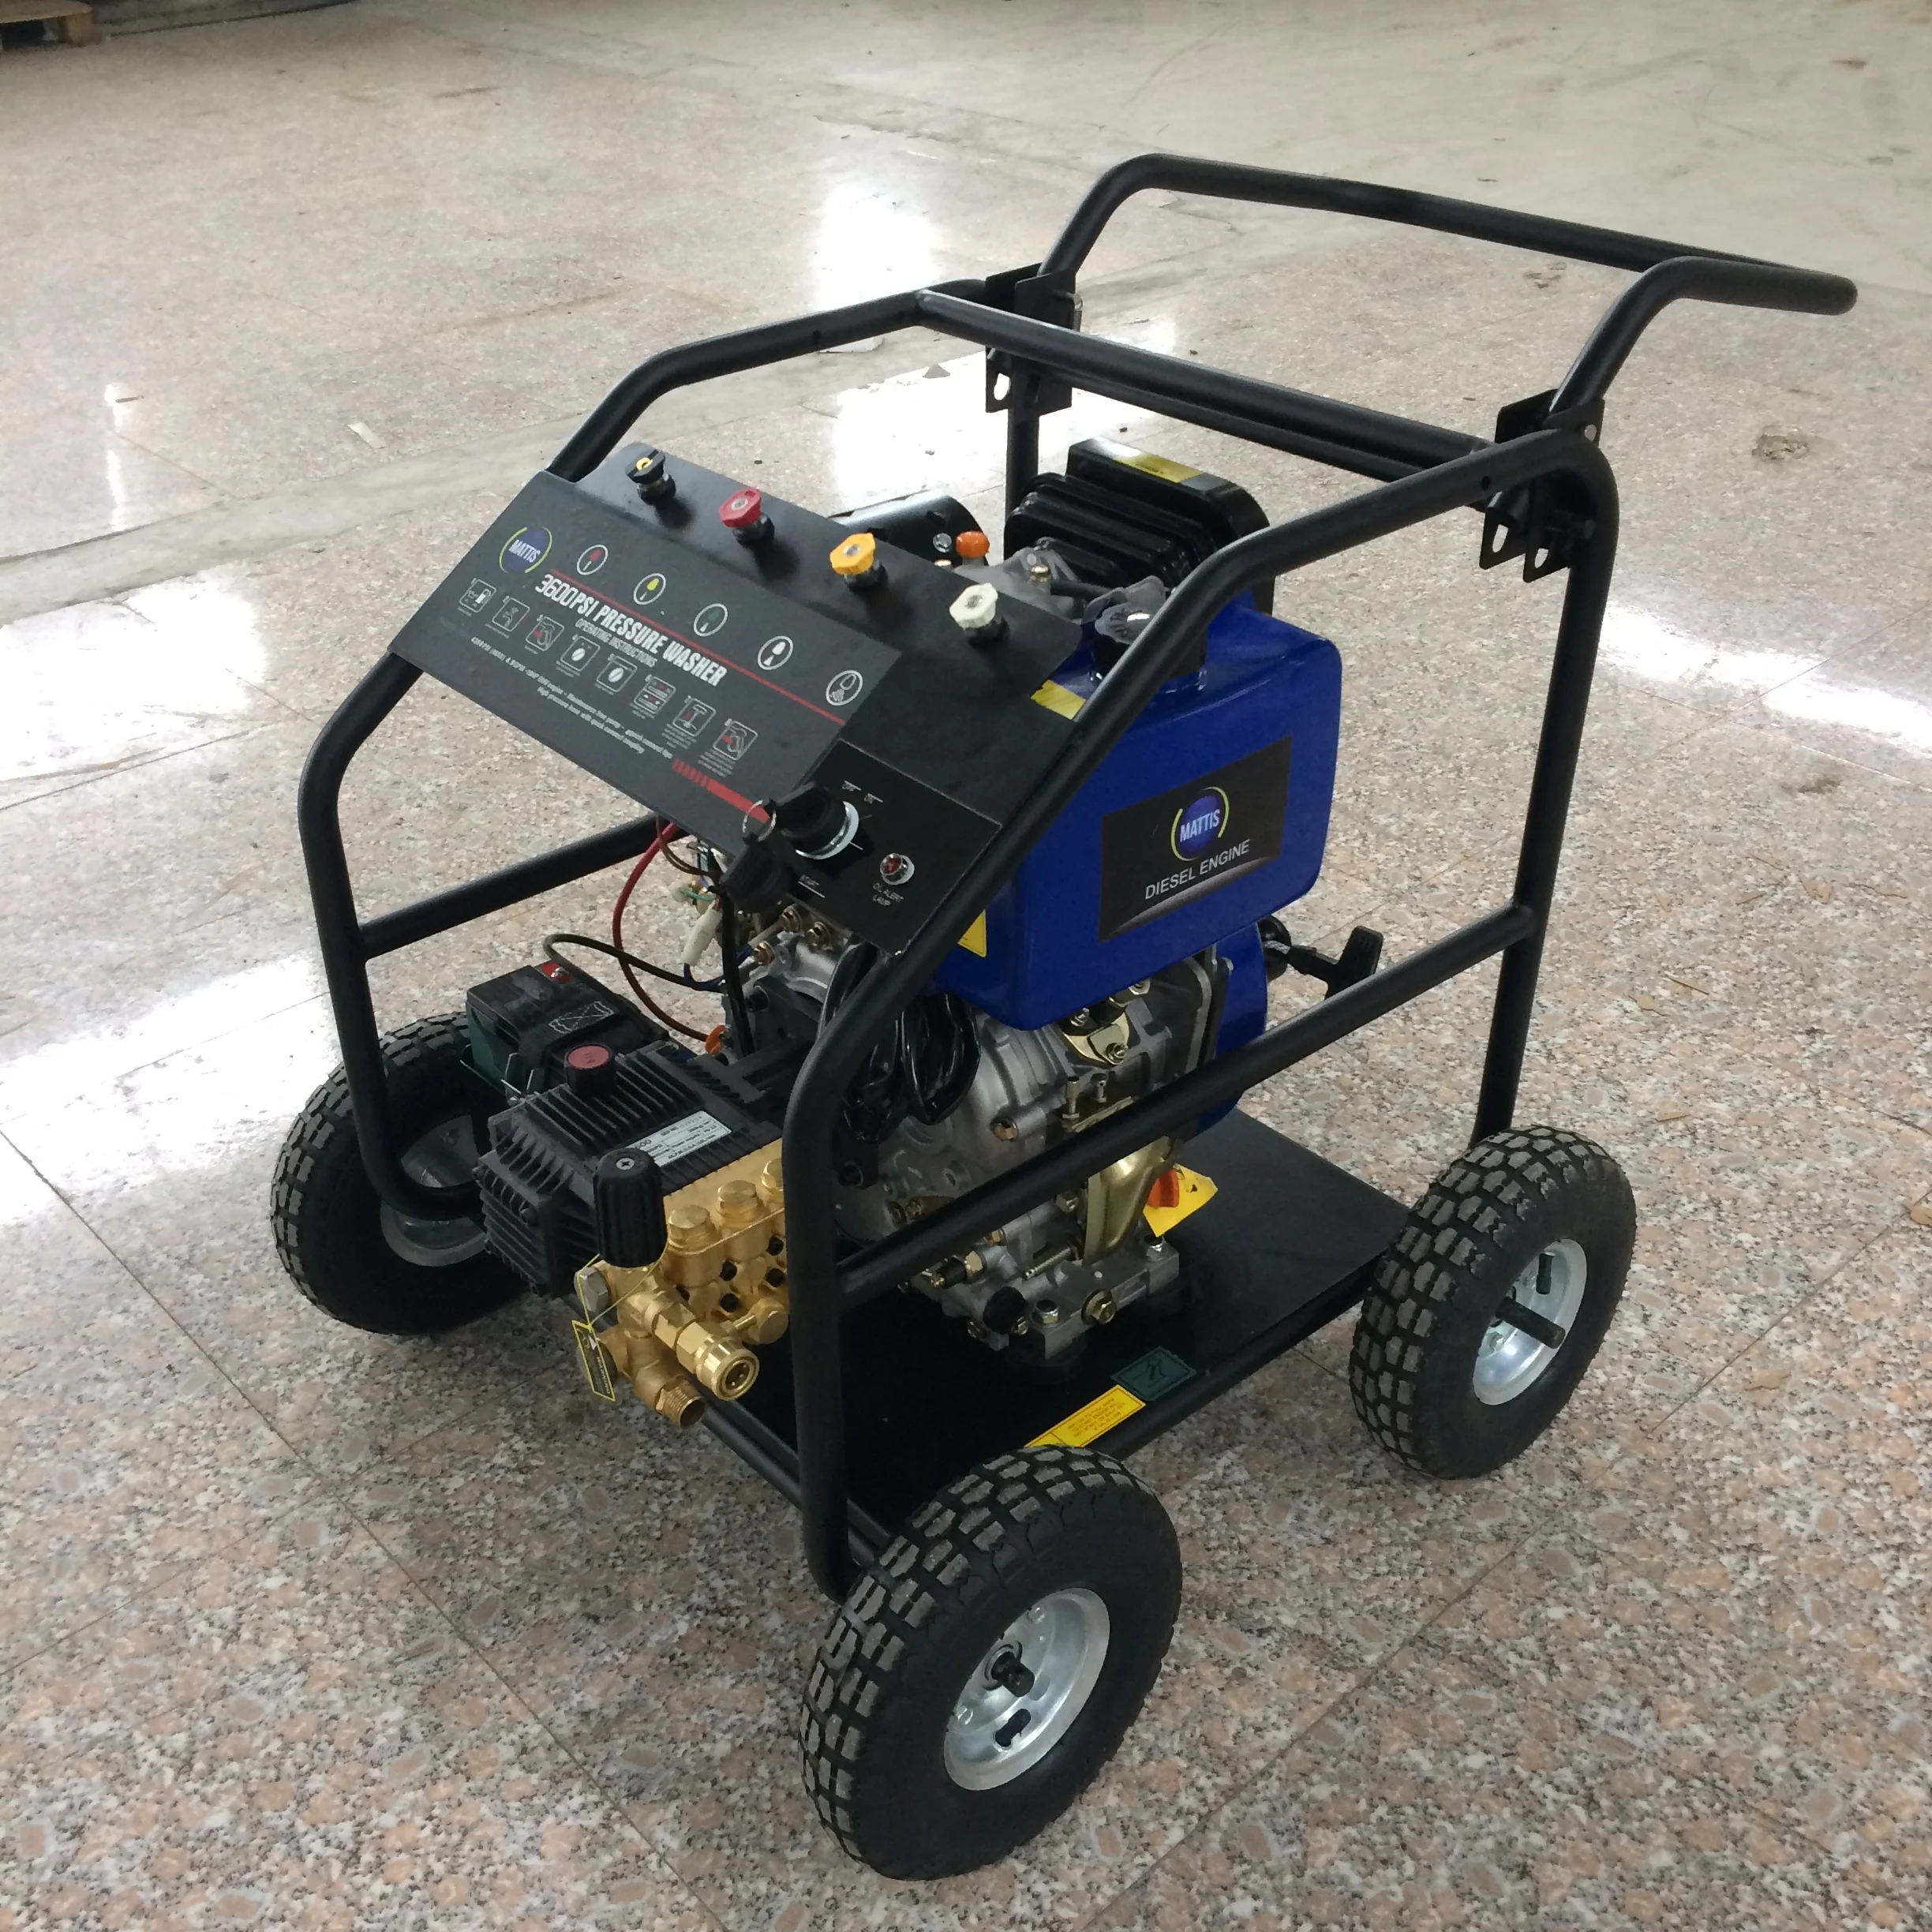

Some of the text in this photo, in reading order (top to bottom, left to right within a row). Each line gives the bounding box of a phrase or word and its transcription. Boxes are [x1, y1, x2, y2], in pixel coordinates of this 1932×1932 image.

[508, 539, 541, 563] MATTIS
[535, 575, 727, 686] 3600PSI PRESSURE WASHER
[575, 618, 658, 668] OPERATING INSTRUCTIONS
[1180, 809, 1221, 842] MATTIS
[1145, 839, 1250, 900] DIESEL ENGINE
